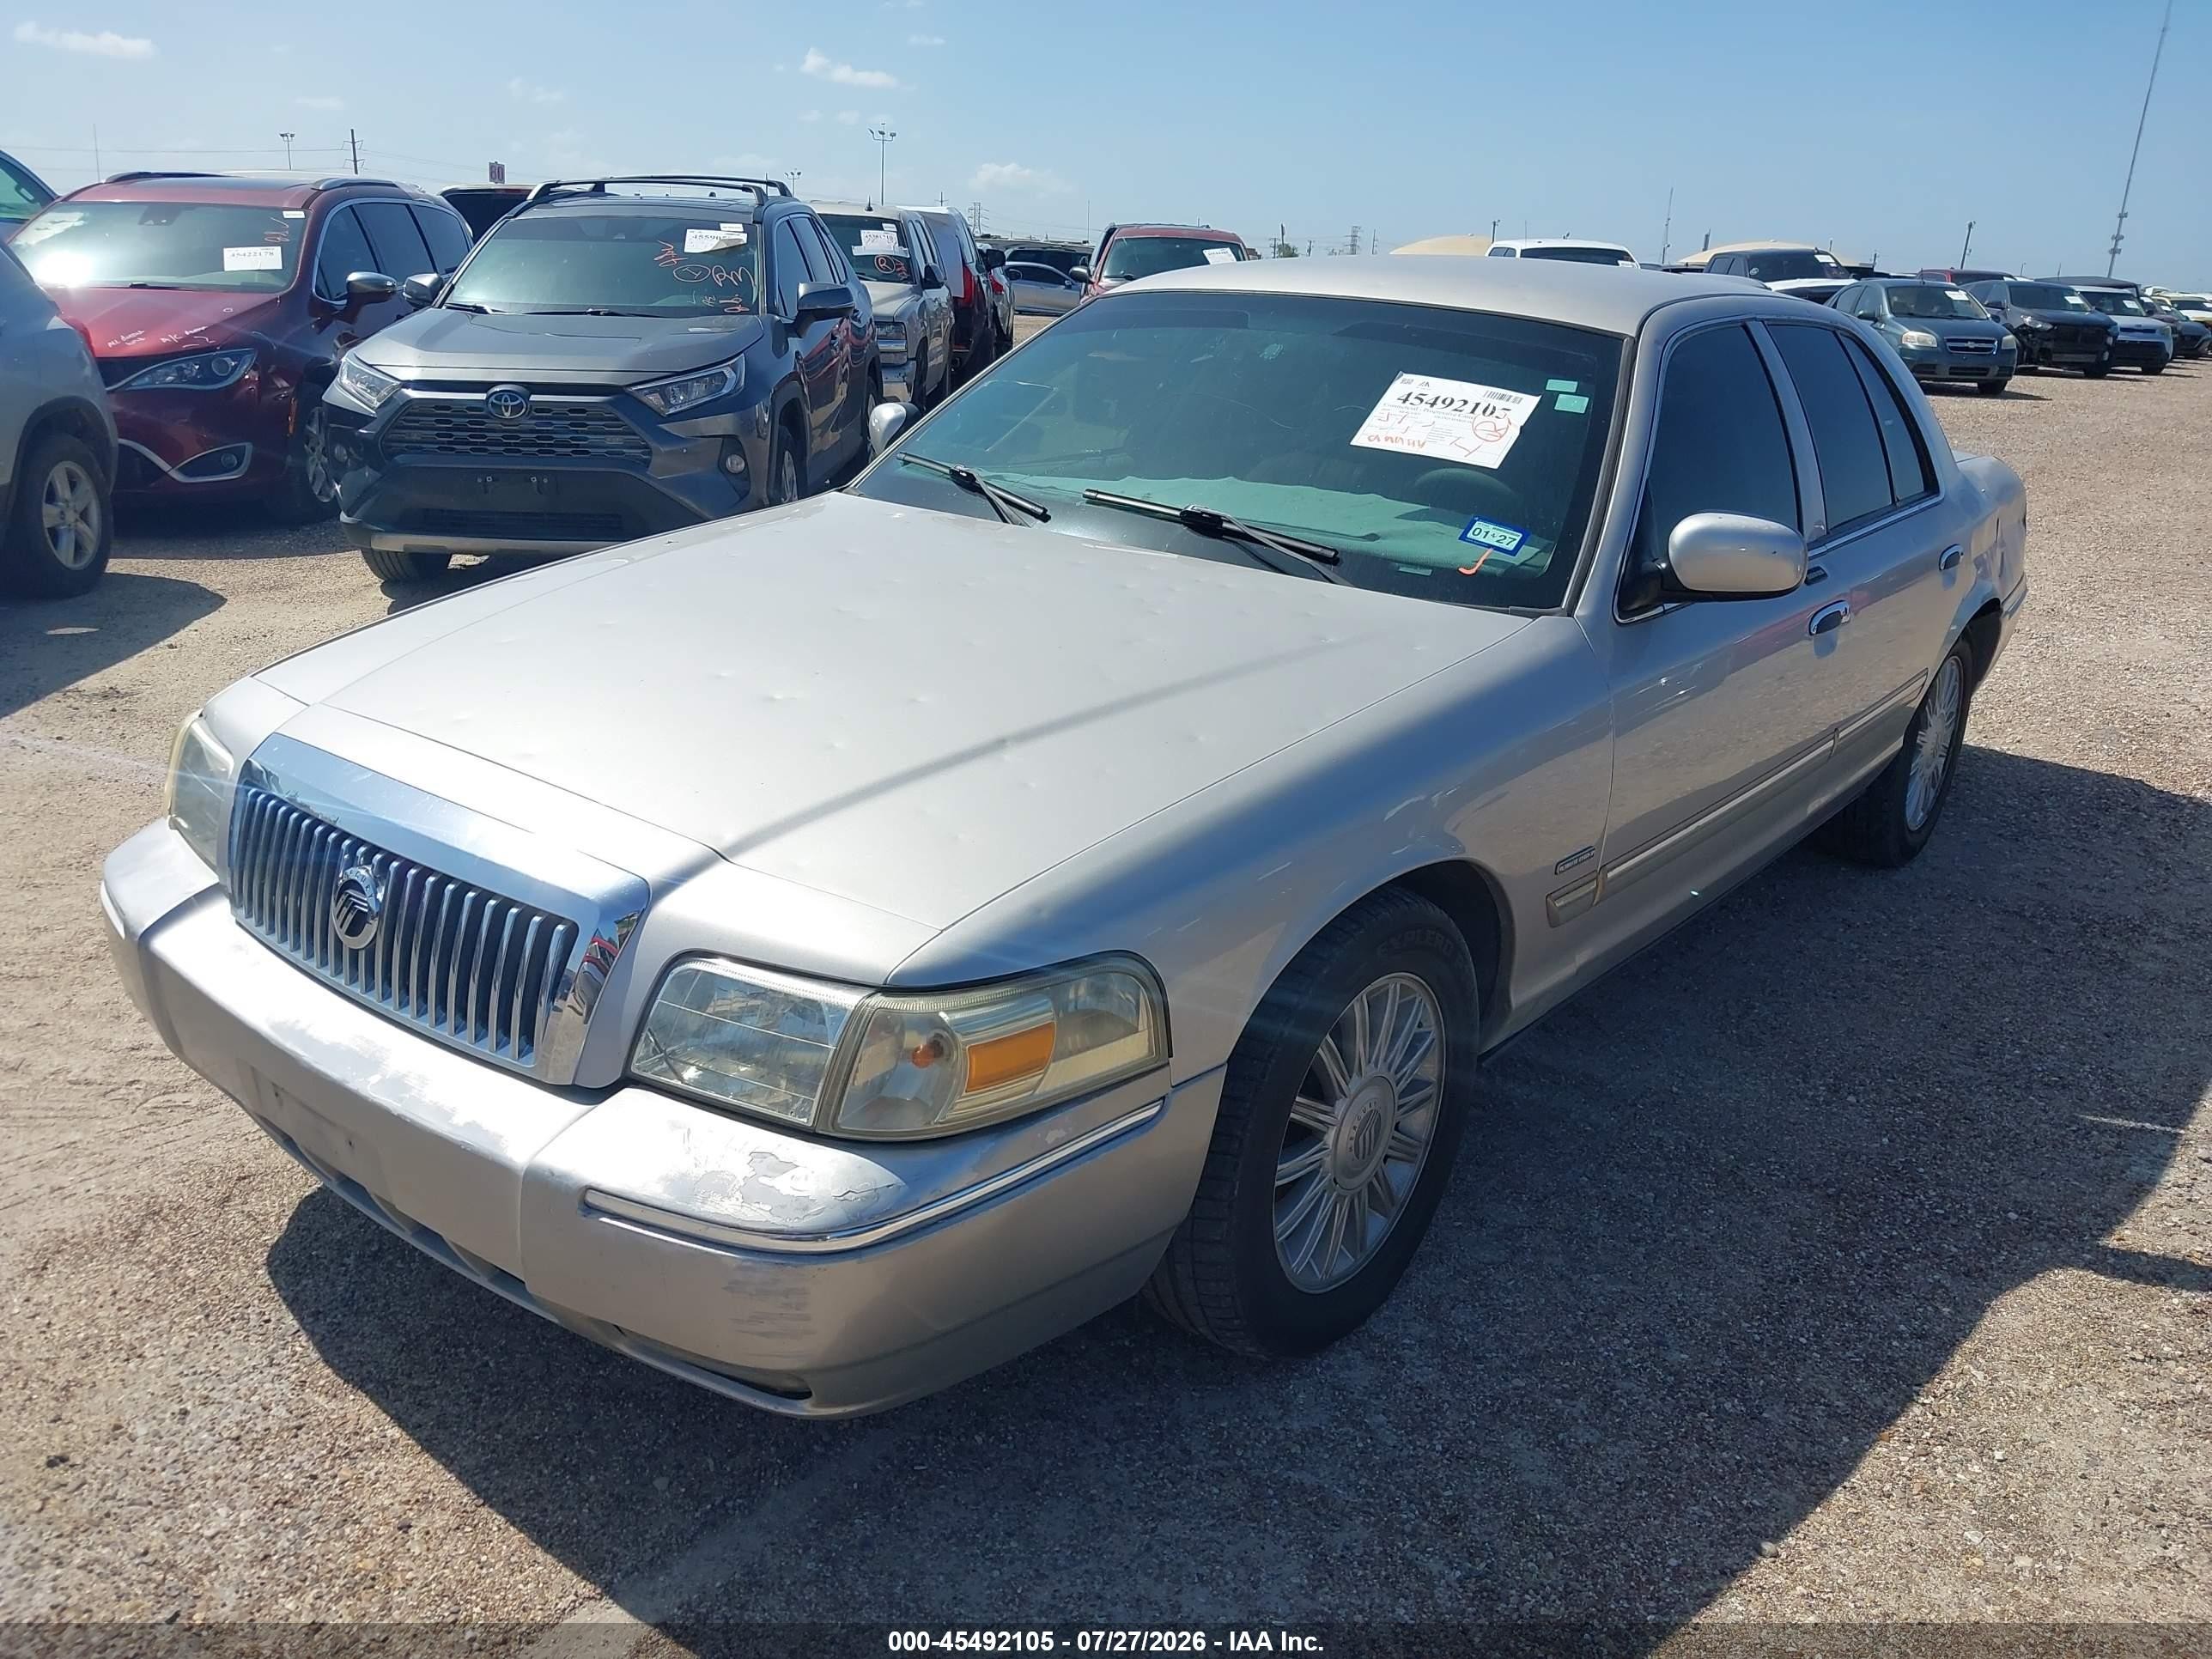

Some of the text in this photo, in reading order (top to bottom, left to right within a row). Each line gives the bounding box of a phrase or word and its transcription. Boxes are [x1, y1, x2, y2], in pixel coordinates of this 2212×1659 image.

[1396, 391, 1512, 420] 45492105
[1472, 527, 1490, 539] 01
[1495, 534, 1517, 546] 27
